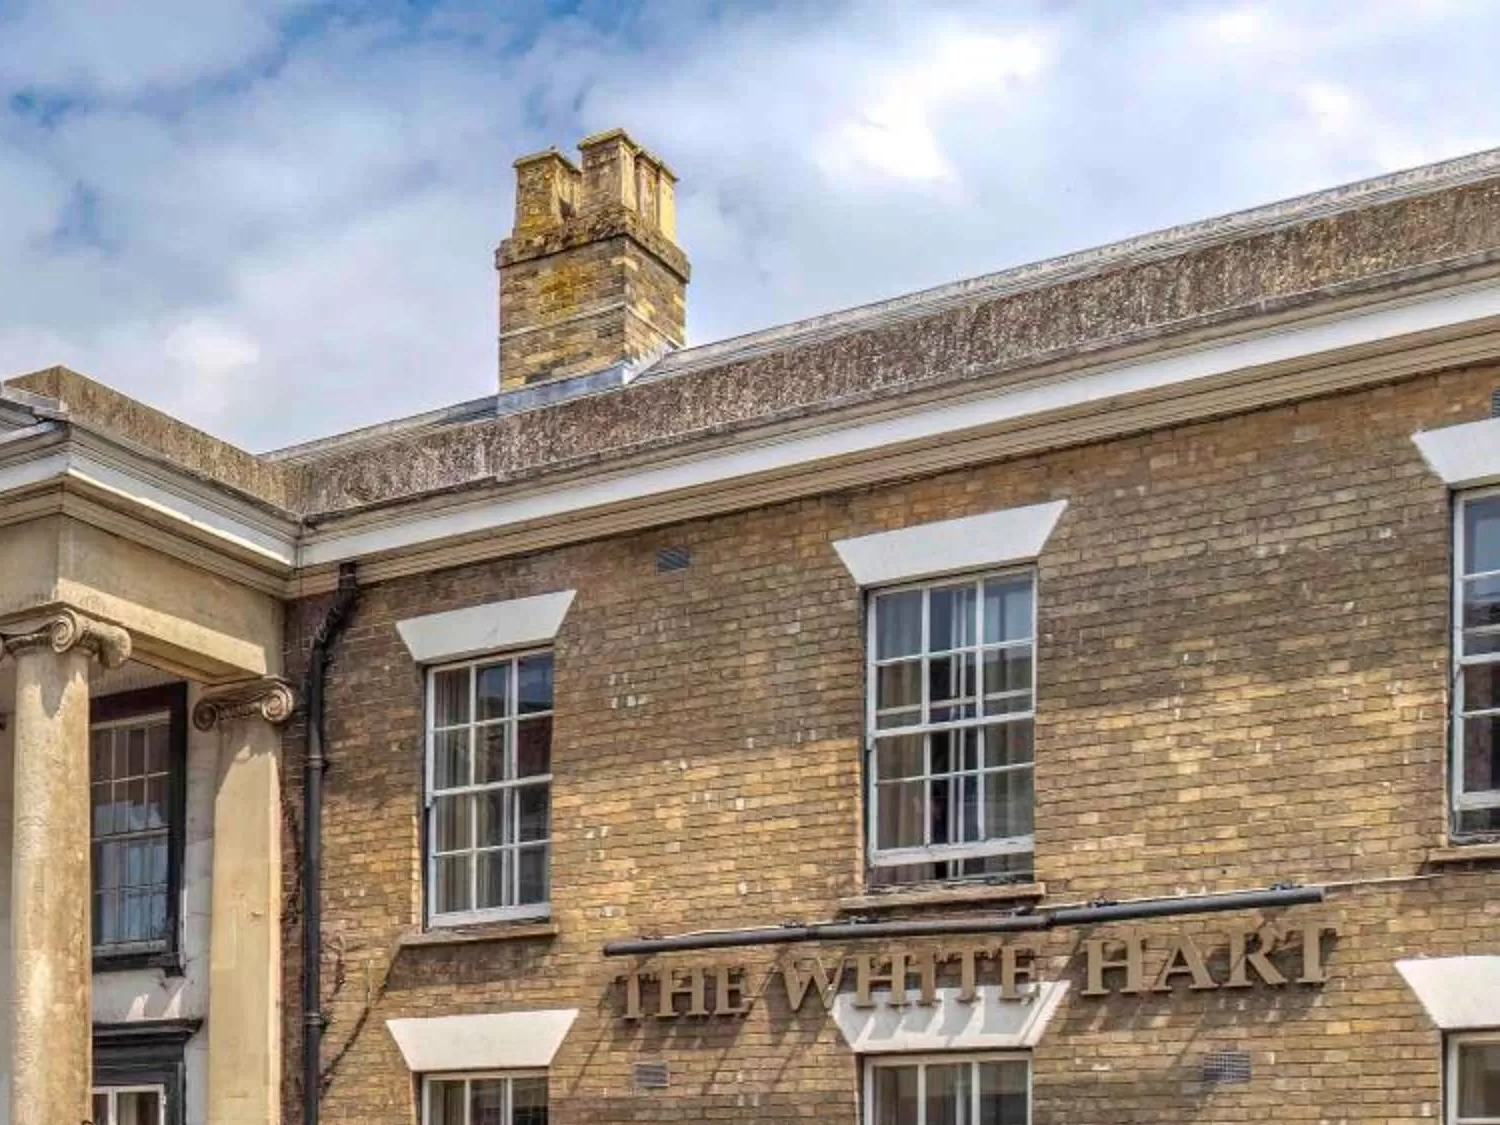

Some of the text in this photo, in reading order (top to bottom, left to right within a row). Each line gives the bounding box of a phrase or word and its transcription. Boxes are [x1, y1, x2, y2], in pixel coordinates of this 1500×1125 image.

[614, 920, 1342, 1018] THE WHITE HART
